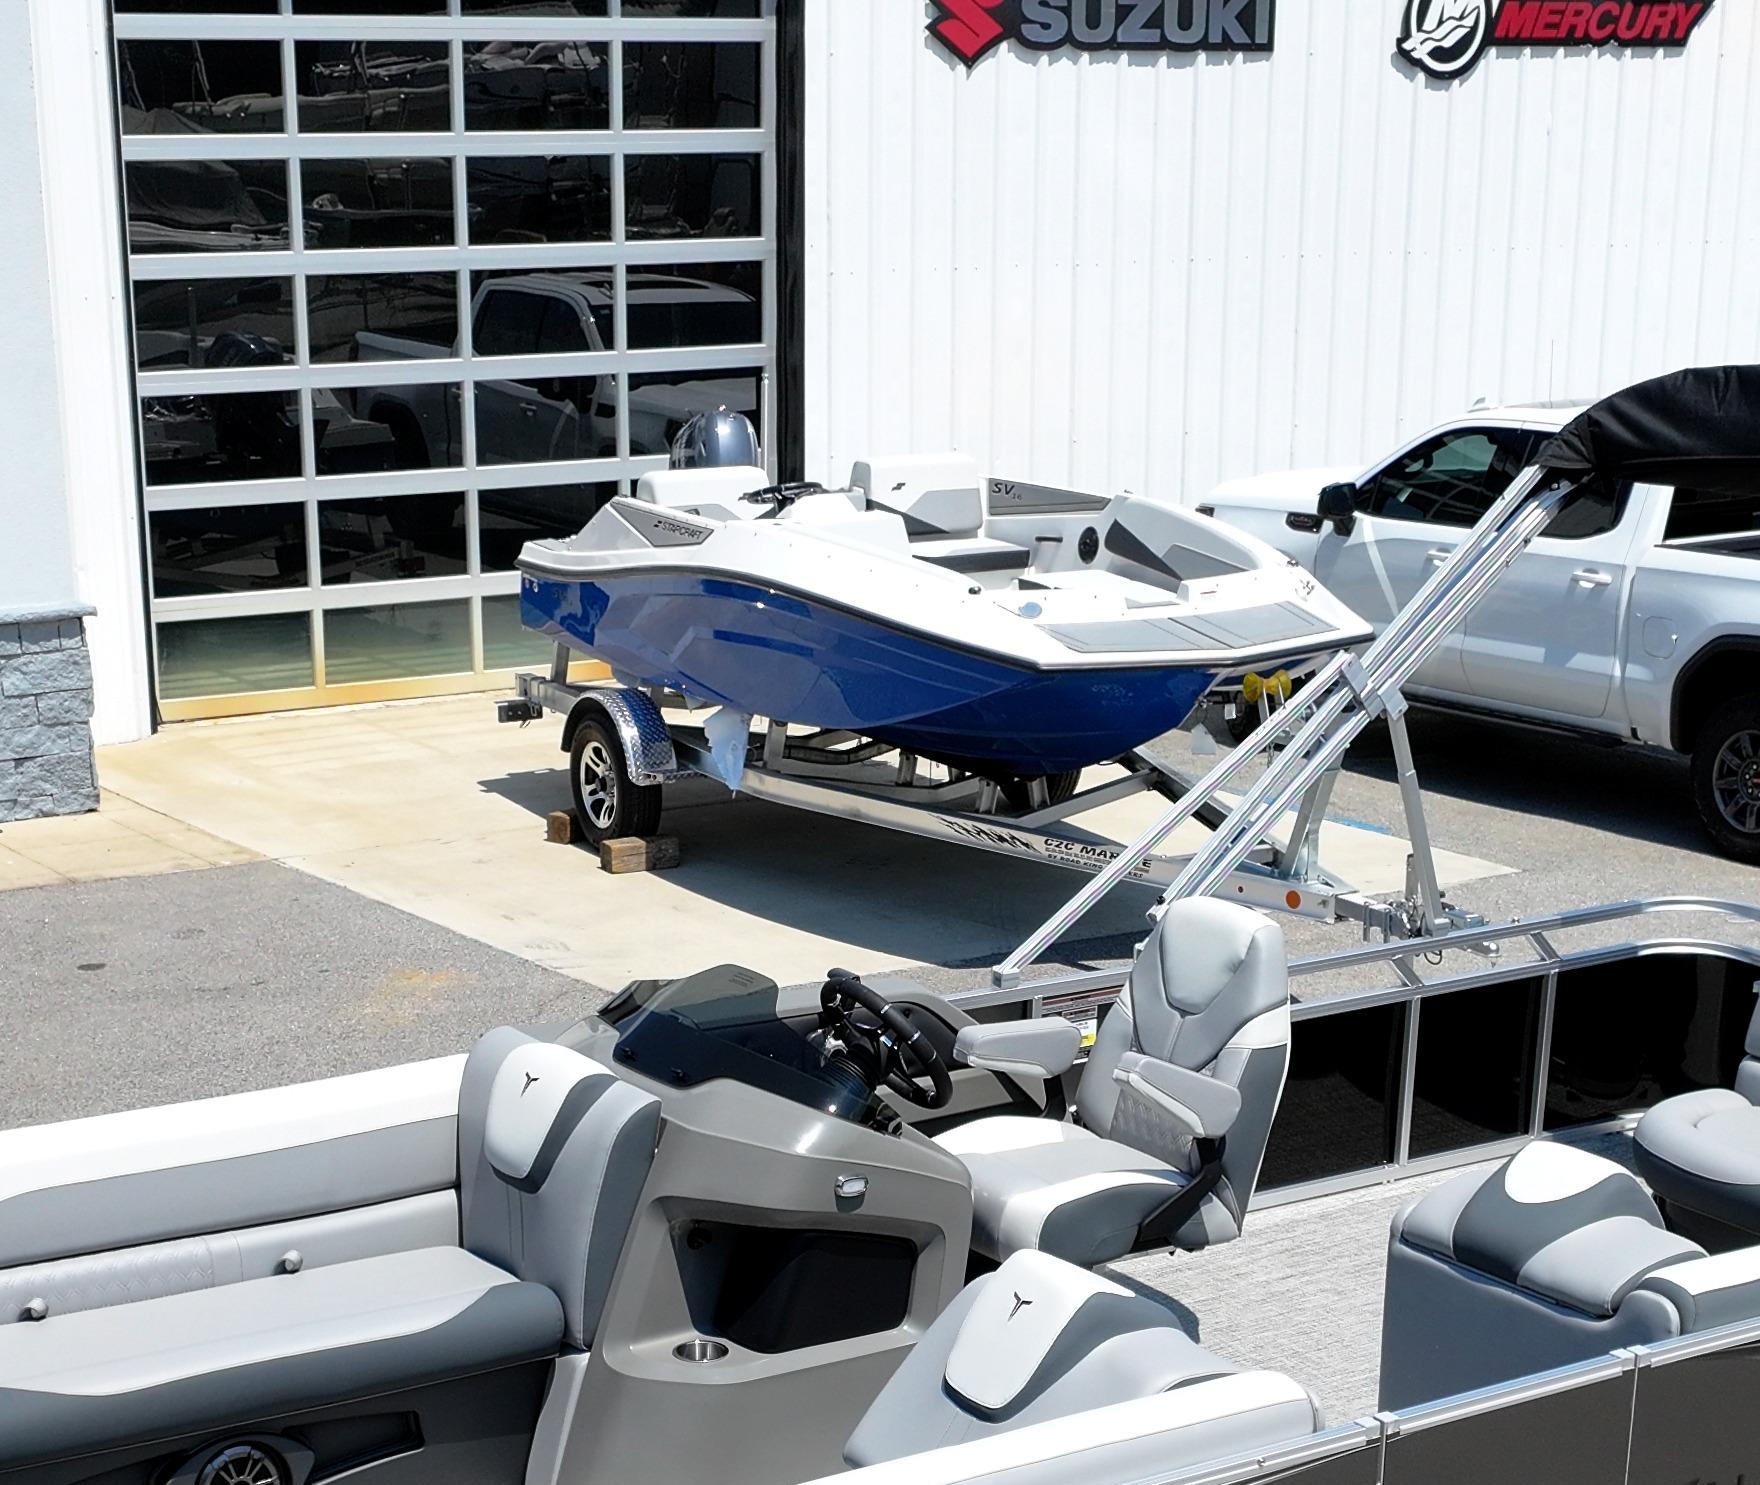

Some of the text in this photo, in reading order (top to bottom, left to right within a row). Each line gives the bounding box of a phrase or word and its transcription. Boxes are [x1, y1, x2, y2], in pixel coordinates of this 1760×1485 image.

[1020, 0, 1270, 44] SUZUKI
[1493, 1, 1703, 40] MERCURY
[1079, 845, 1153, 868] MARE
